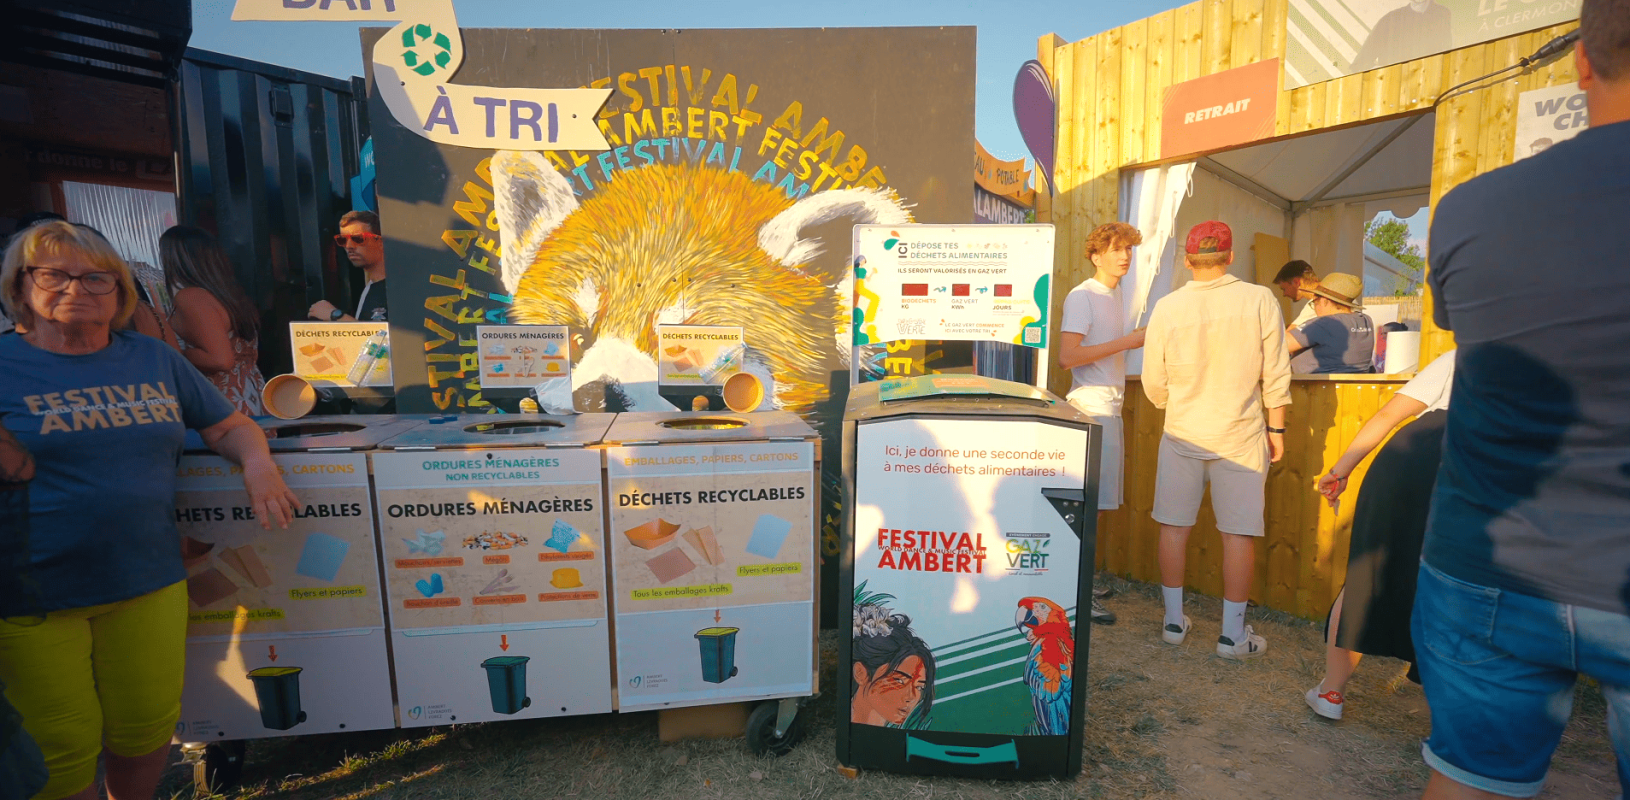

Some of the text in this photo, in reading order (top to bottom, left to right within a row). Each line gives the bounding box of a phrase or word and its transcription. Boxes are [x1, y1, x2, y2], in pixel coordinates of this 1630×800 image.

[1494, 0, 1578, 29] CLERMON
[423, 86, 558, 143] À TRI
[1184, 97, 1251, 125] RETRAIT
[597, 136, 742, 182] FESTIVAL
[898, 242, 908, 258] ICI
[910, 241, 943, 249] DÉPOSE
[910, 251, 947, 259] DÉCHETS
[23, 382, 175, 415] FESTIVAL
[117, 400, 145, 408] MUSIC
[146, 398, 177, 407] FESTIVAL
[40, 404, 182, 434] AMBERT
[624, 452, 799, 466] EMBALLAGES, PAPIERS, CARTONS
[885, 445, 1066, 460] Ici, je donne une seconde vie
[292, 464, 355, 474] CARTONS
[422, 456, 559, 471] ORDURES MÉNAGÈRES
[883, 462, 892, 472] à
[894, 464, 921, 473] mes
[924, 463, 975, 475] déchets
[978, 465, 1056, 477] alimentaires
[446, 471, 540, 481] NON RECYCLABLES
[619, 486, 805, 507] DÉCHETS RECYCLABLES
[387, 495, 594, 518] ORDURES MÉNAGÈRES
[175, 507, 225, 522] HETS
[878, 528, 987, 551] FESTIVAL
[1005, 539, 1041, 554] GAZ
[877, 553, 987, 573] AMBERT
[1006, 553, 1049, 568] VERT
[739, 564, 798, 575] Flyers et papiers
[291, 587, 363, 598] Flyers et papiers
[633, 585, 729, 598] Tous les emballages krafts
[257, 608, 281, 617] krafts
